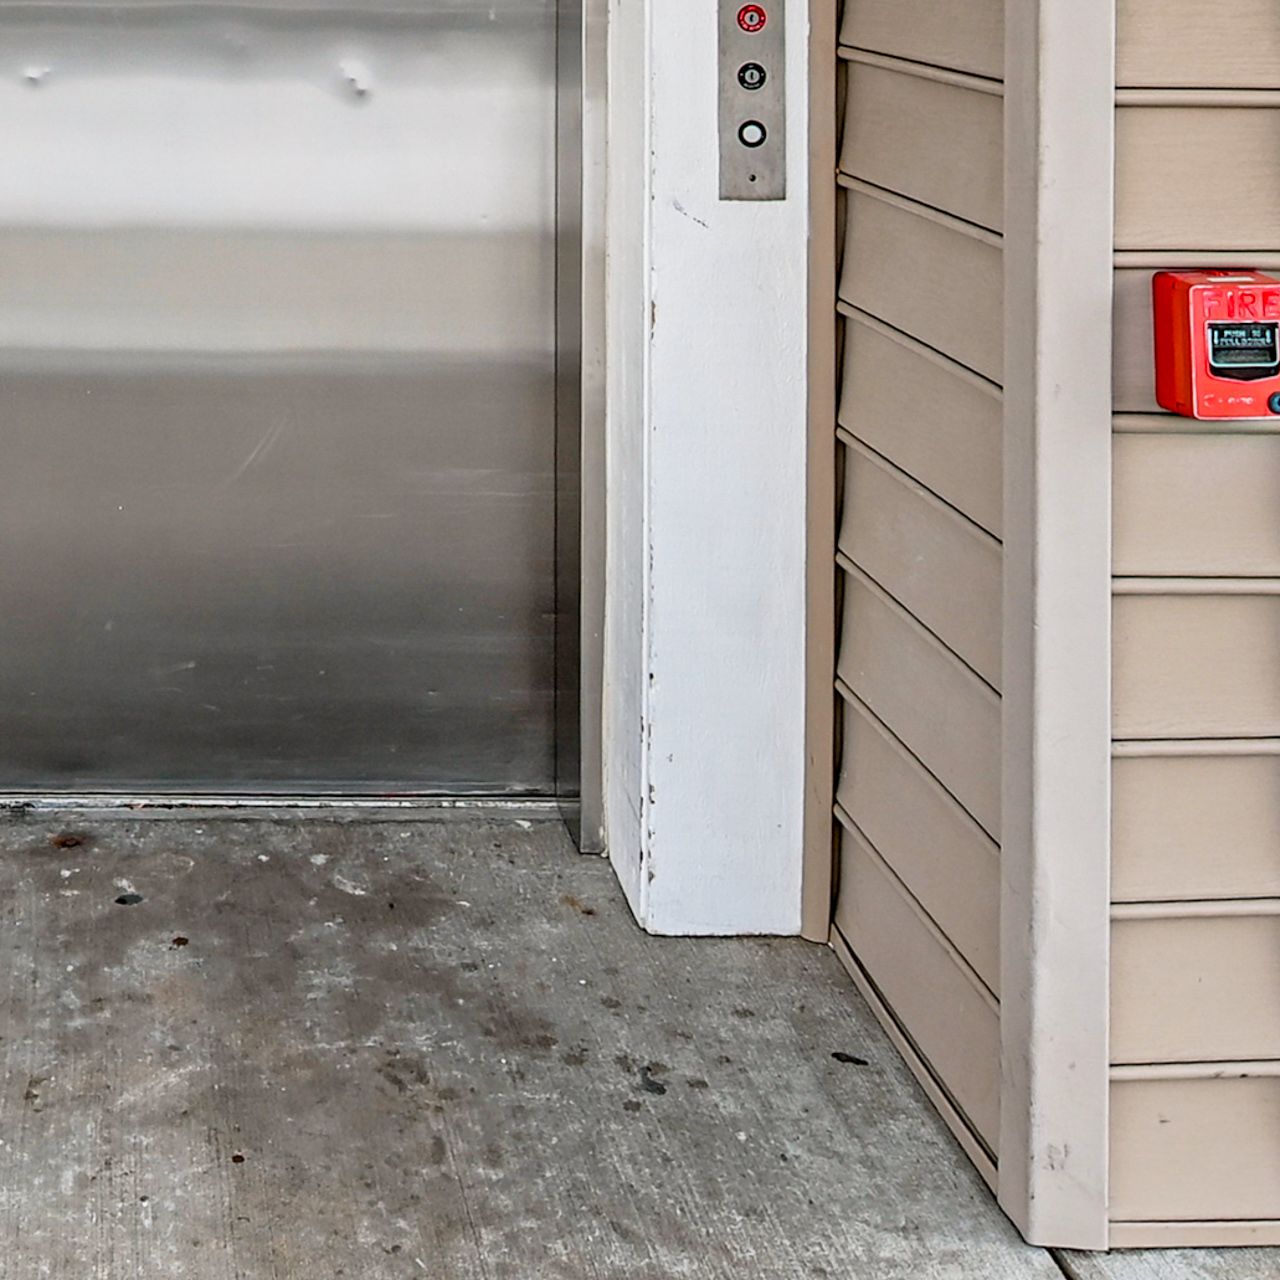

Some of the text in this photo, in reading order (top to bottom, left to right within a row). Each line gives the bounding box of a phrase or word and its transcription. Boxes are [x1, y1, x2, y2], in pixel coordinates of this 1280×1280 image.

[200, 222, 208, 235] 2
[263, 223, 271, 236] 3
[1202, 289, 1280, 319] FIRE
